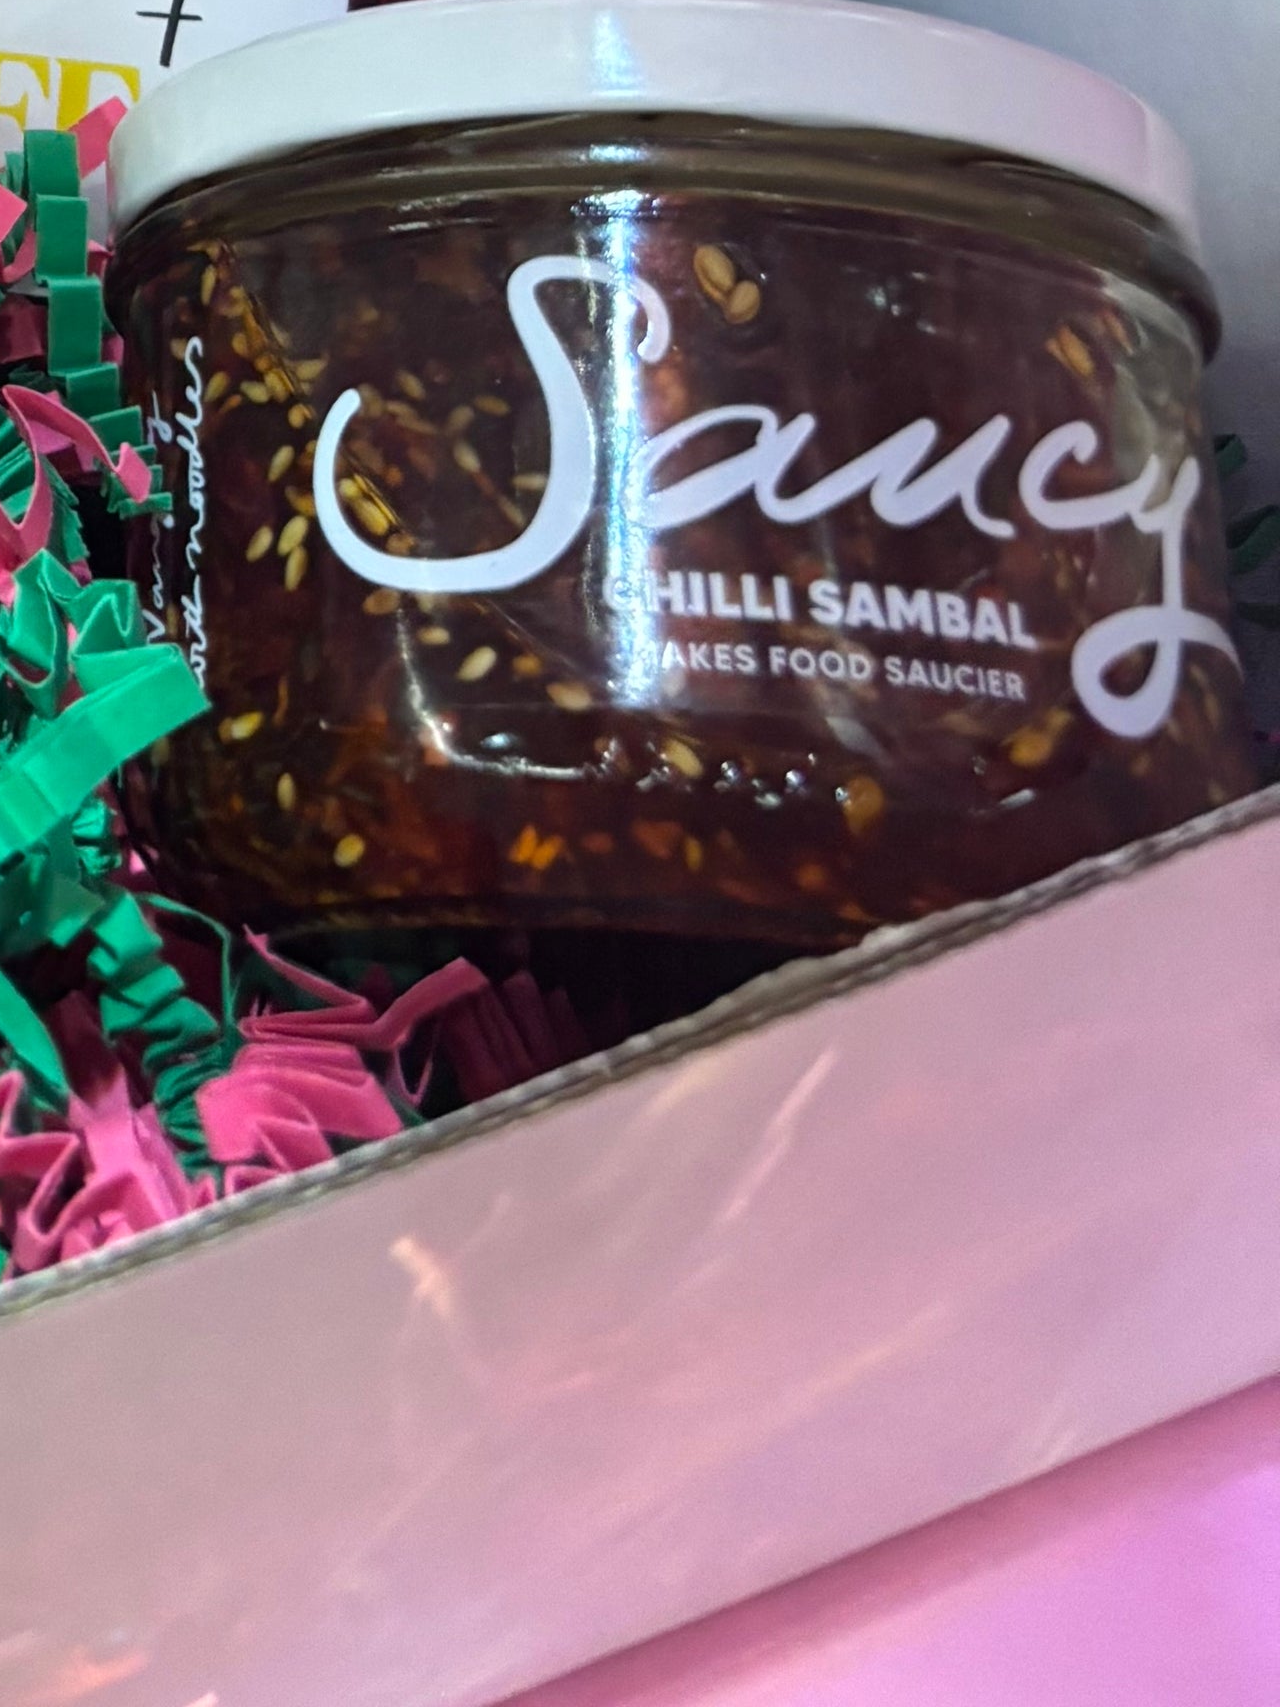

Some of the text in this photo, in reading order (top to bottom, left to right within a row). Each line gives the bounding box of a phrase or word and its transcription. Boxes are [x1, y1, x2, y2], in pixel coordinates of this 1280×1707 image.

[312, 254, 1243, 738] Saucy
[809, 578, 1038, 650] SAMBAL
[769, 644, 872, 681] FOOD
[885, 657, 1025, 702] SAUCIER
